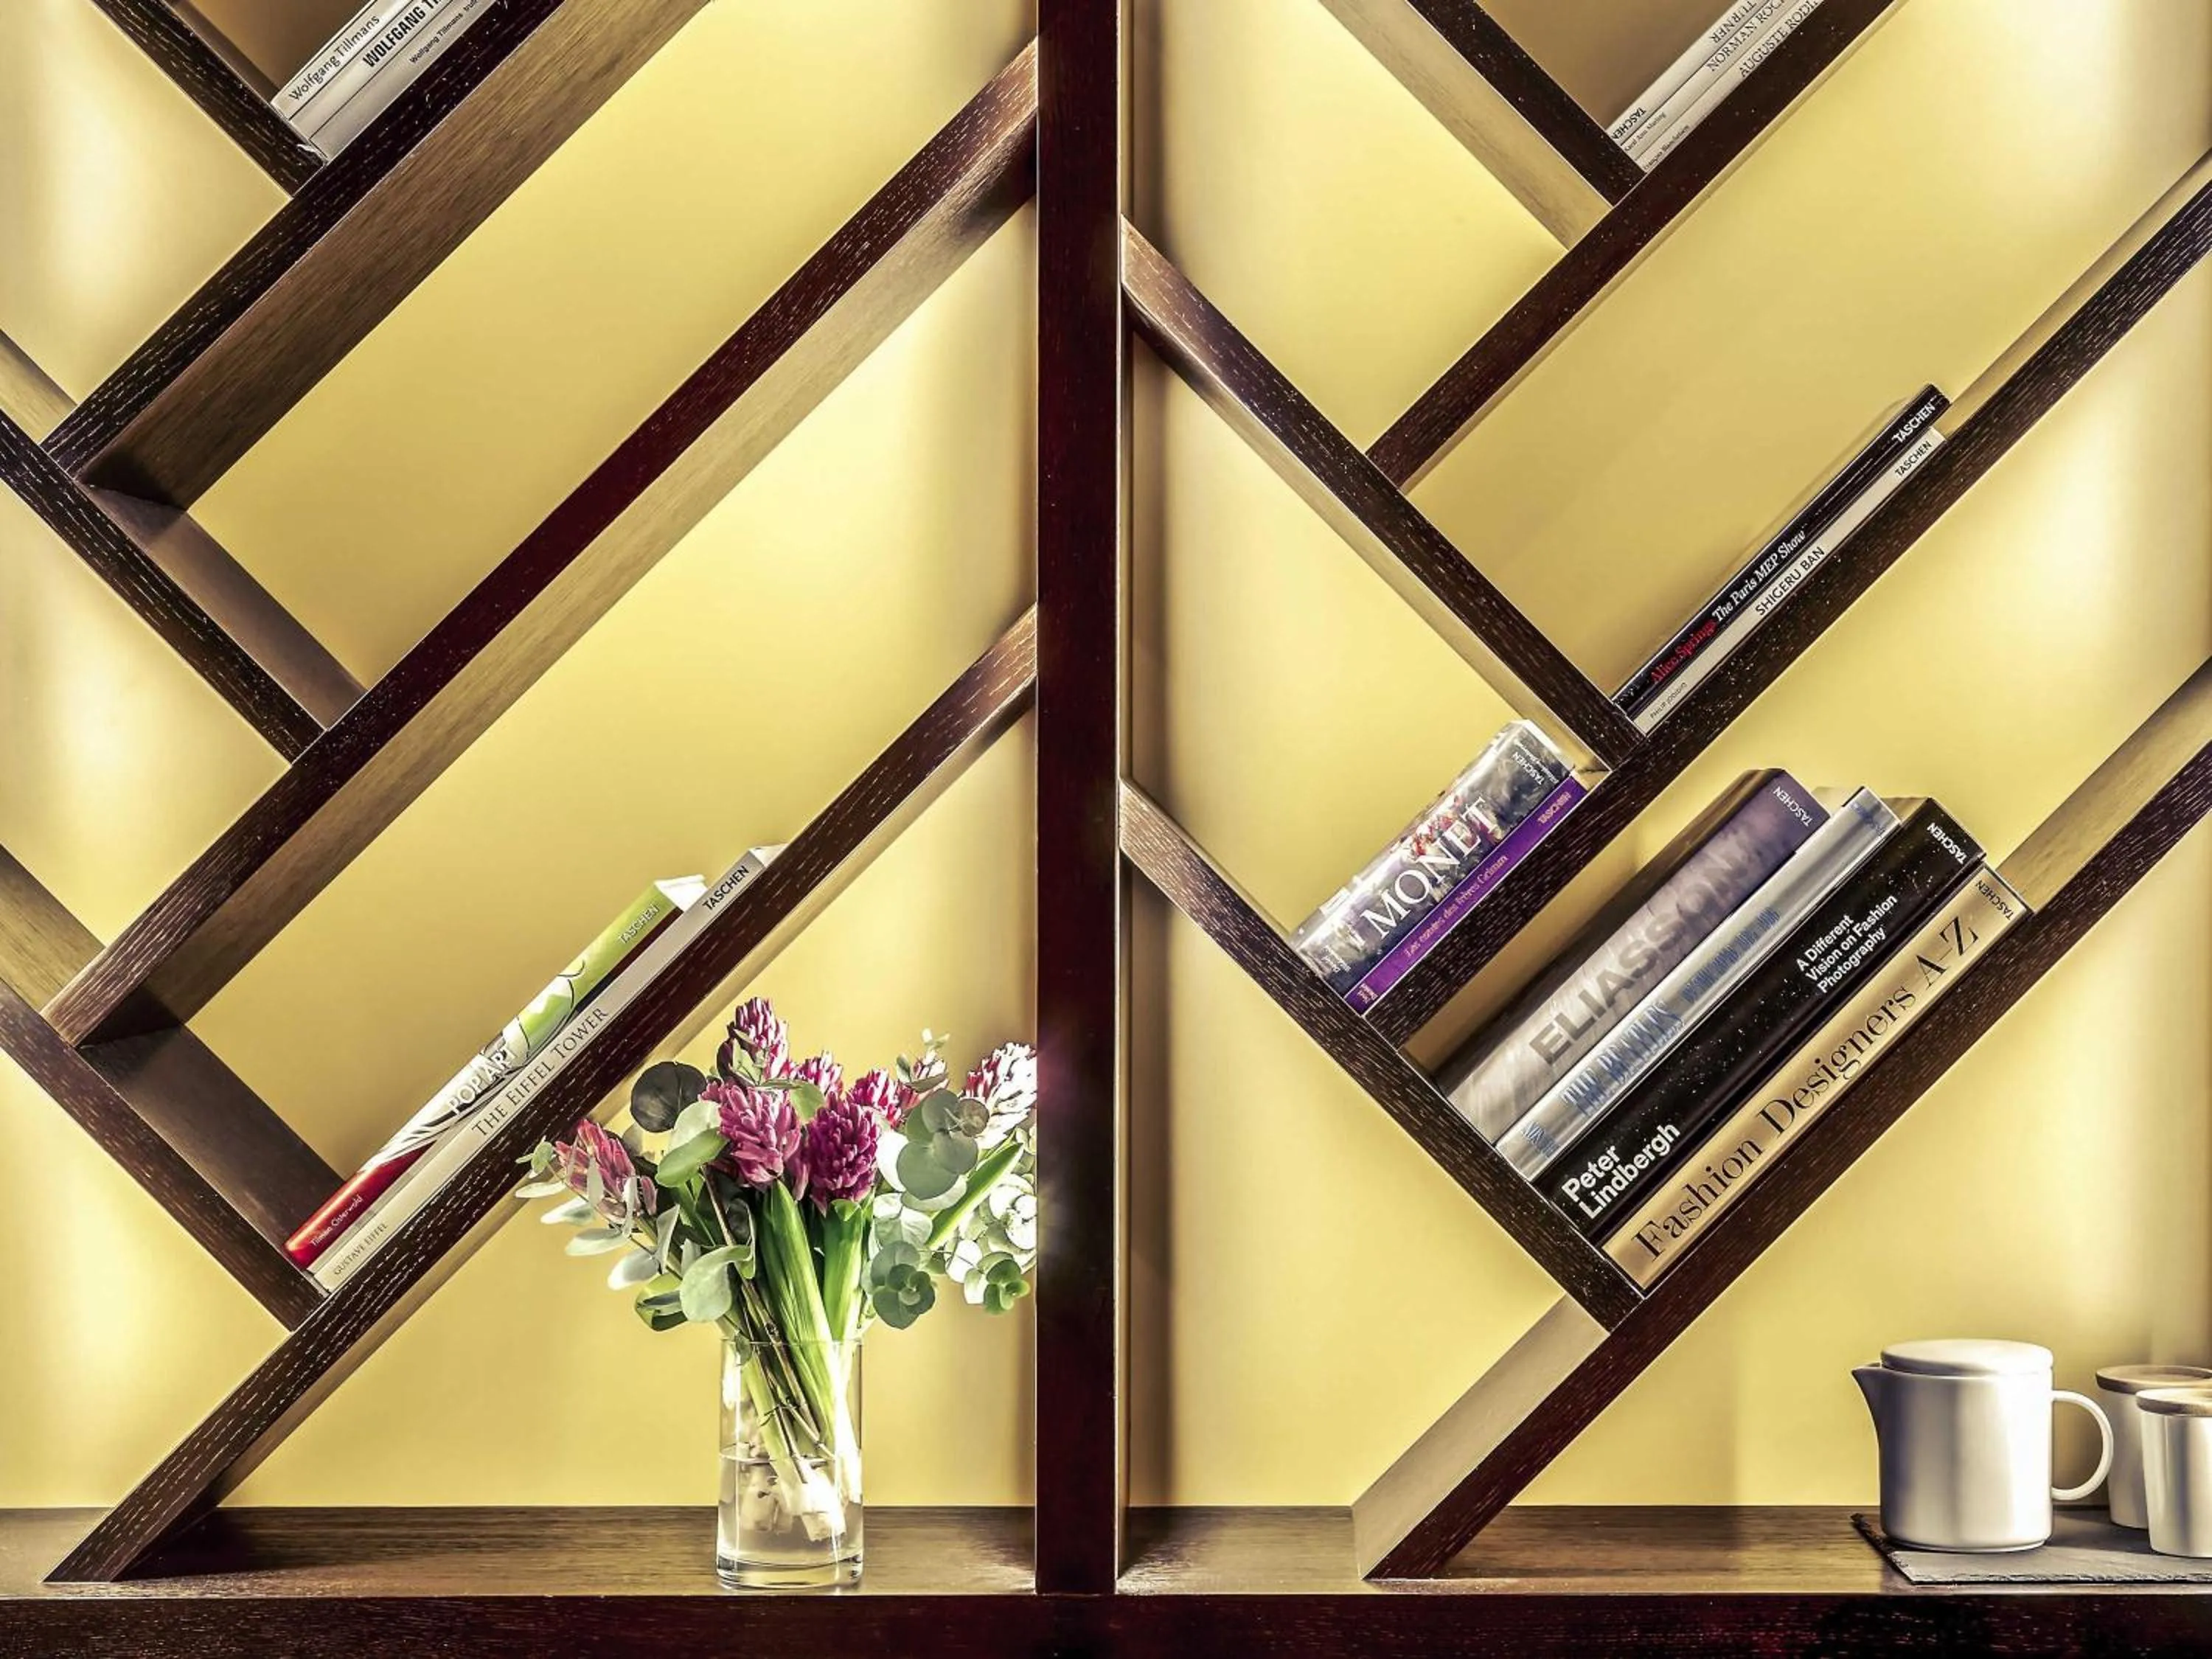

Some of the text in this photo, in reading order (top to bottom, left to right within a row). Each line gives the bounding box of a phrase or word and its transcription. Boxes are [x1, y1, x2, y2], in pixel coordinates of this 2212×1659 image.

[363, 6, 426, 68] WOLFGANG
[1706, 0, 1785, 72] NORMAN ROC
[1710, 0, 1757, 44] TURNER
[288, 15, 380, 101] Wolfgang Tillmans
[1739, 27, 1789, 77] AUGUSTE
[1611, 107, 1646, 140] TASCHEN
[1891, 401, 1936, 442] TASCHEN
[1894, 440, 1933, 476] TASCHEN
[1711, 602, 1733, 622] The
[1730, 579, 1758, 606] Paris
[1753, 553, 1779, 582] MEP
[1777, 530, 1806, 559] Show
[1756, 546, 1826, 616] SHIGERU BAN
[1512, 751, 1545, 785] TASCHEN
[1772, 786, 1813, 827] TASCHEN
[1360, 796, 1496, 939] MONET
[1927, 822, 1967, 865] TASCHEN
[702, 865, 750, 911] TASCHEN
[1975, 880, 2014, 921] TASCHEN
[618, 903, 661, 944] TASCHEN
[1796, 914, 1854, 972] A Different
[1805, 895, 1898, 981] Vision on Fashion
[1817, 927, 1887, 993] Photography
[449, 1045, 518, 1115] POP ART
[471, 1007, 608, 1136] THE EIFFEL TOWER
[1630, 1139, 1764, 1262] Fashion
[1755, 985, 1916, 1139] Designers
[1916, 916, 1979, 990] A-Z
[1561, 1145, 1621, 1203] Peter
[1579, 1124, 1681, 1219] Lindbergh
